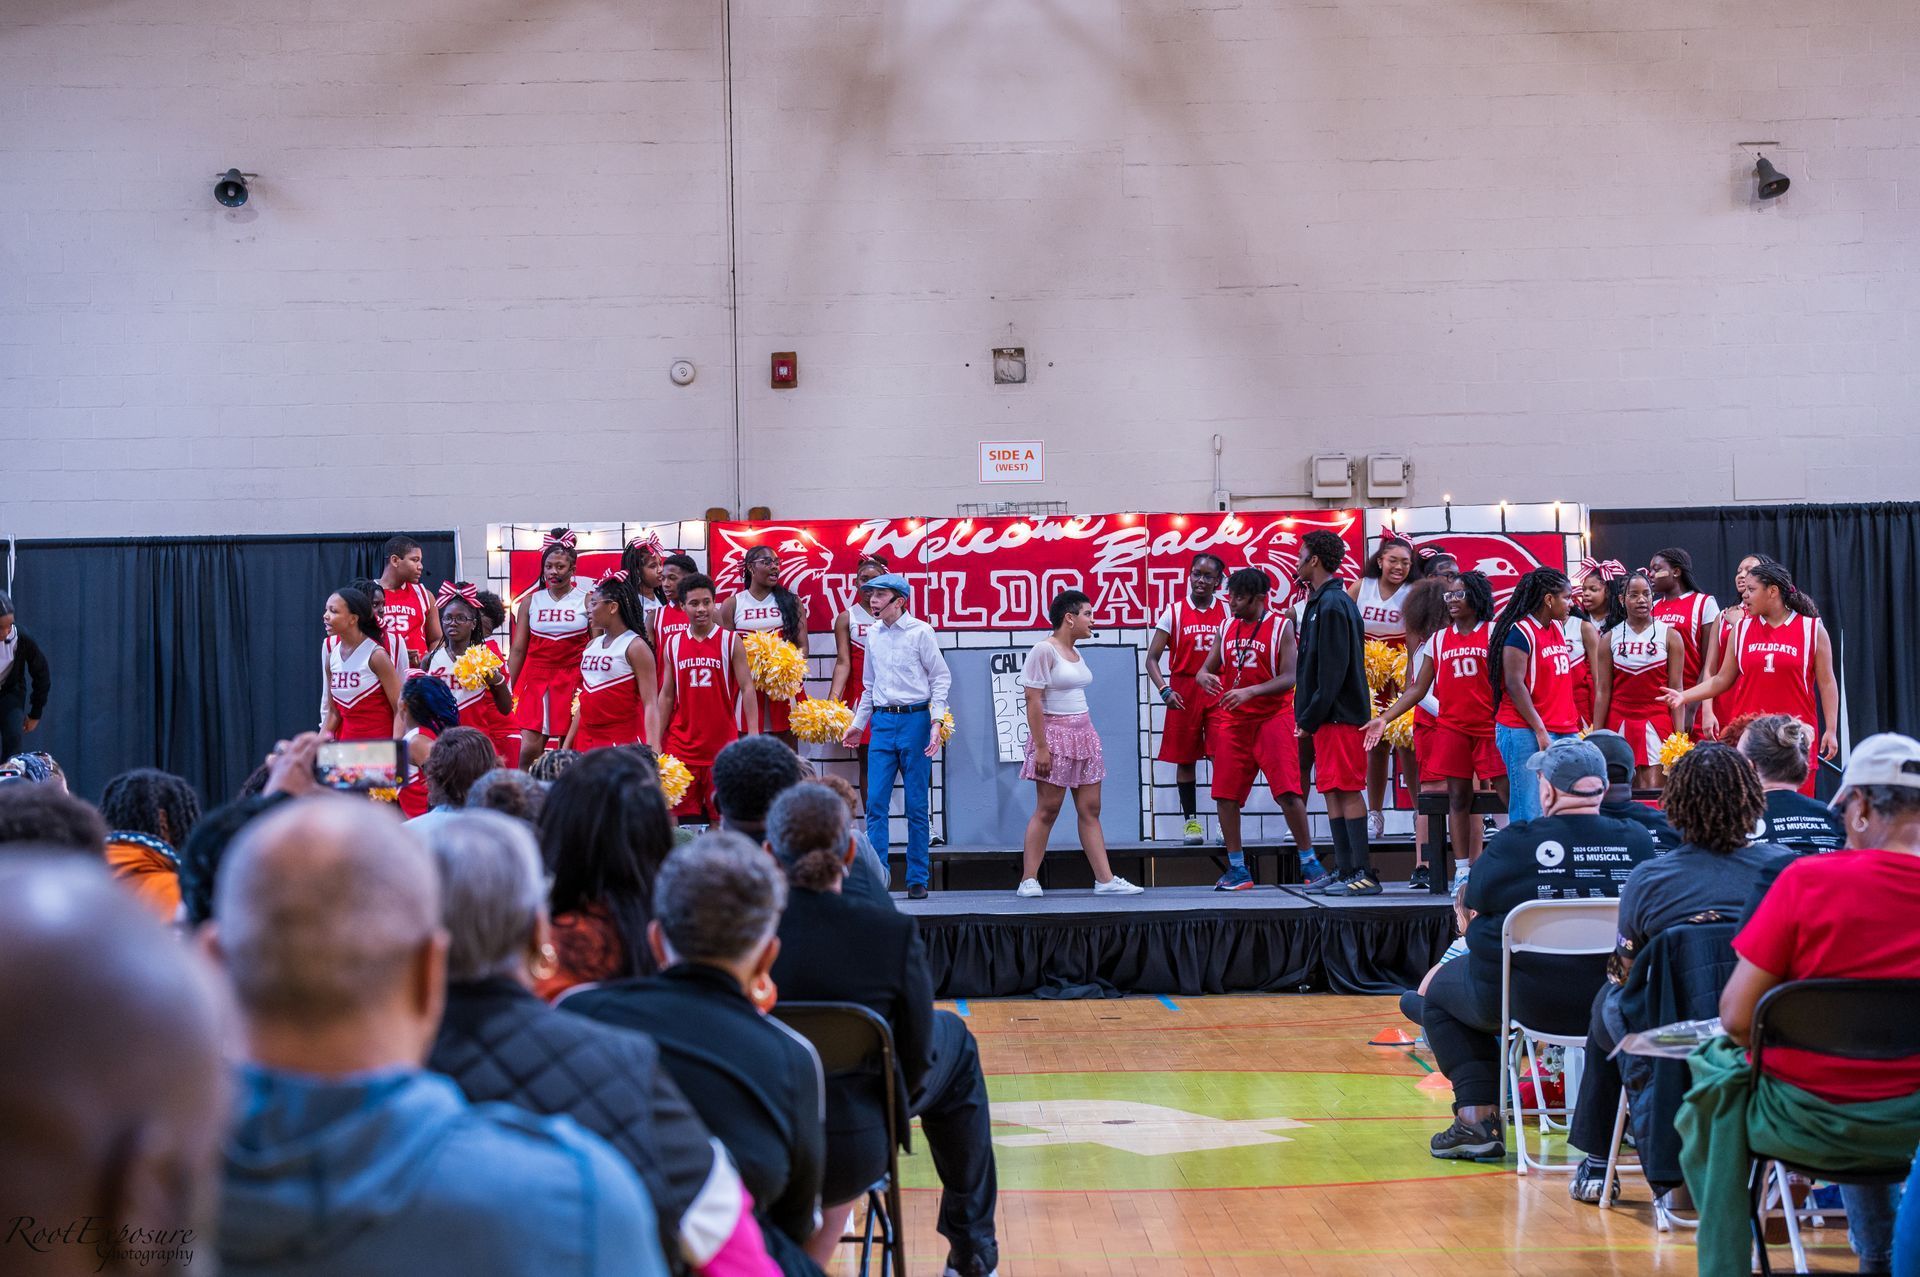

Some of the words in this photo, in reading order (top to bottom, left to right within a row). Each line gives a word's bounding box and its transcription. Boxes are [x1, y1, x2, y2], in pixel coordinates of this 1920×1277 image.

[989, 450, 1021, 461] SIDE
[1024, 450, 1035, 461] A
[995, 463, 1029, 472] (WEST)
[847, 515, 1106, 564] Welcome
[1090, 513, 1254, 574] Back
[823, 567, 1231, 632] ILDCAT
[383, 605, 416, 616] ILDCATS
[538, 609, 576, 622] EHS
[745, 607, 781, 621] EHS
[1363, 606, 1400, 623] EHS
[385, 614, 410, 633] 25
[663, 624, 690, 634] WILDC
[1184, 625, 1220, 635] WILDCA
[1195, 634, 1216, 651] 13
[1226, 639, 1266, 653] WIDCATS
[1748, 643, 1798, 657] WILDCATS
[1231, 650, 1258, 668] 32
[1442, 648, 1489, 661] WILDCATS
[581, 655, 614, 671] EHS
[679, 658, 721, 670] WILDCATS
[1452, 657, 1479, 678] 10
[1554, 655, 1570, 675] 18
[1763, 654, 1776, 672] 1
[331, 672, 361, 688] EHS
[690, 669, 712, 687] 12
[1574, 854, 1585, 862] HS
[1586, 854, 1621, 862] MUSICAL
[1622, 854, 1633, 862] JR.
